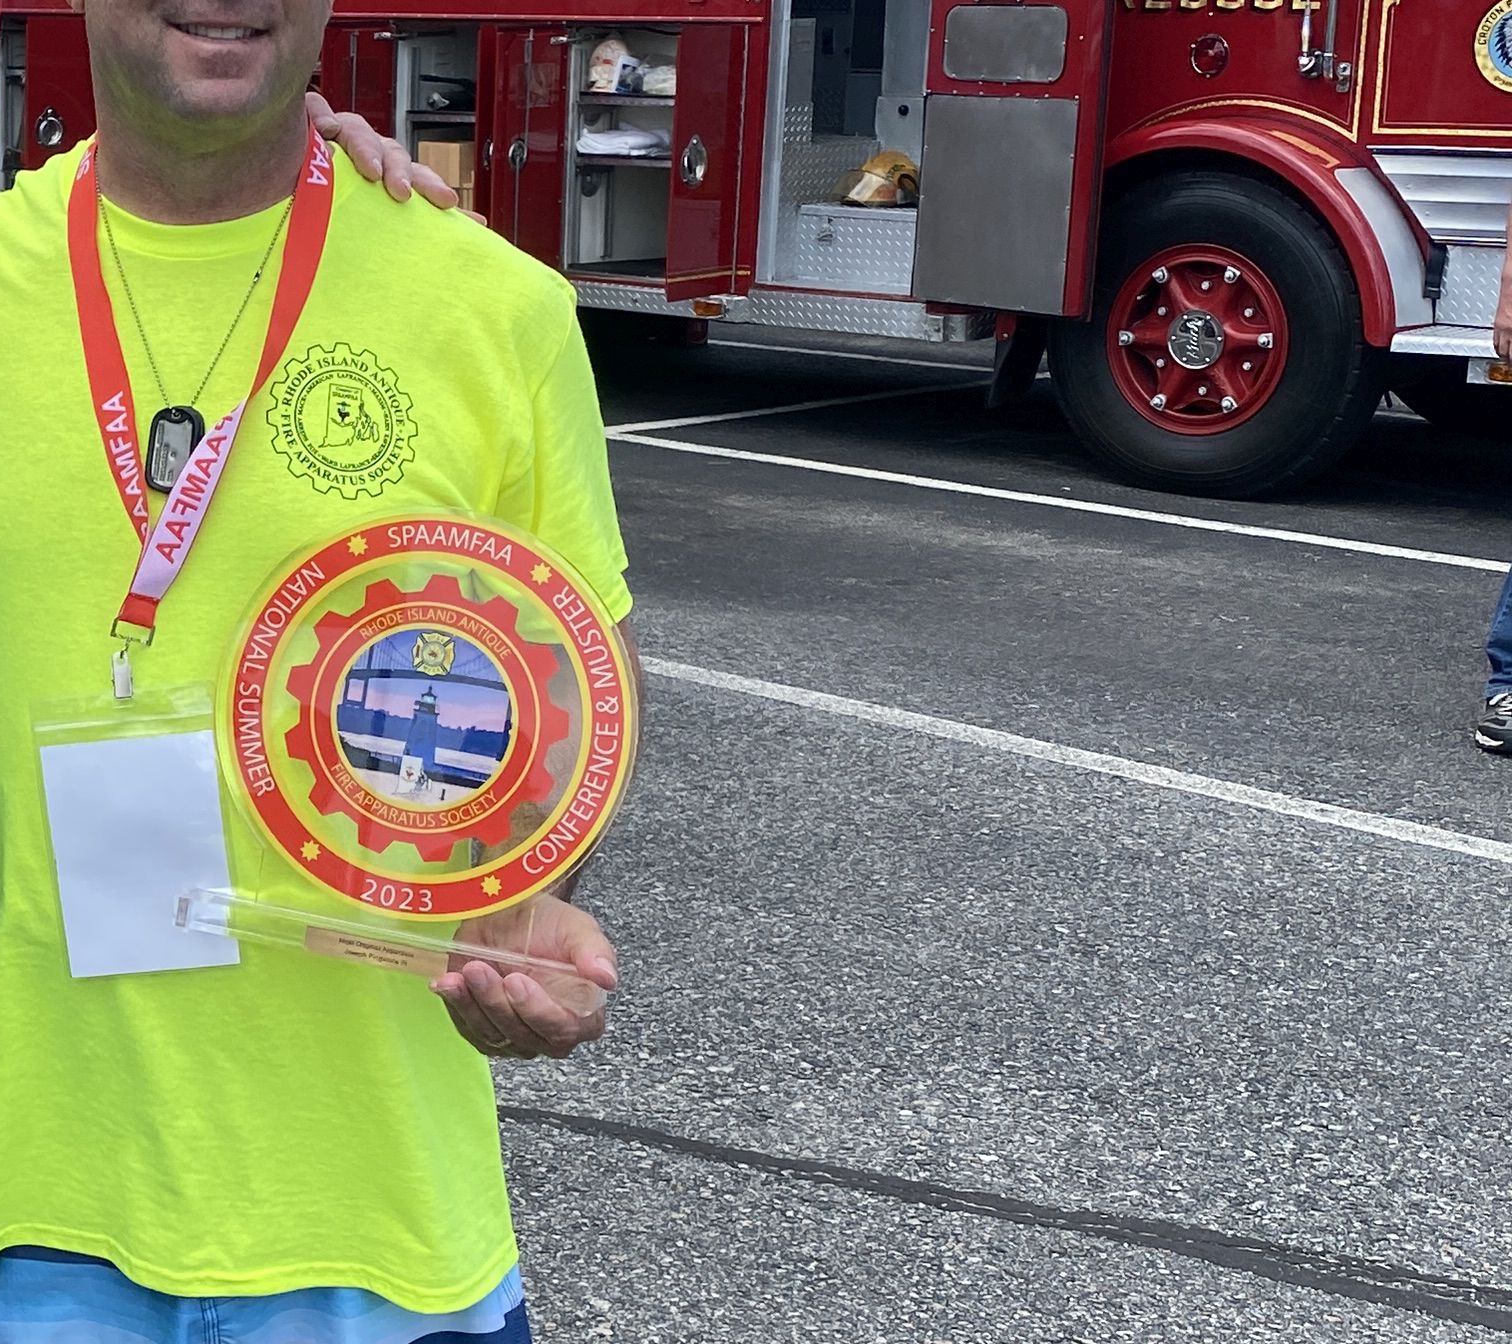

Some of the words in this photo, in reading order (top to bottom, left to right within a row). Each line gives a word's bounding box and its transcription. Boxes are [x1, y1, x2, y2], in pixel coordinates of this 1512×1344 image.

[282, 363, 316, 407] RHODE
[316, 356, 369, 373] ISLAND
[369, 371, 406, 427] ANTIQUE
[281, 413, 298, 449] FIRE
[293, 449, 366, 486] APPARATUS
[368, 433, 406, 482] SOCIETY
[387, 524, 513, 567] SPAAMFAA
[241, 559, 326, 673] NATIONAL
[359, 609, 405, 641] RHODE
[407, 608, 458, 623] ISLAND
[458, 616, 513, 661] ANTIQUE
[552, 585, 617, 690] MUSTER
[235, 680, 276, 797] SUMMER
[595, 696, 619, 714] &
[331, 763, 353, 793] FIRE
[354, 790, 436, 828] APPARATUS
[439, 789, 498, 827] SOCIETY
[521, 722, 619, 876] CONFERENCE
[359, 878, 433, 912] 2023
